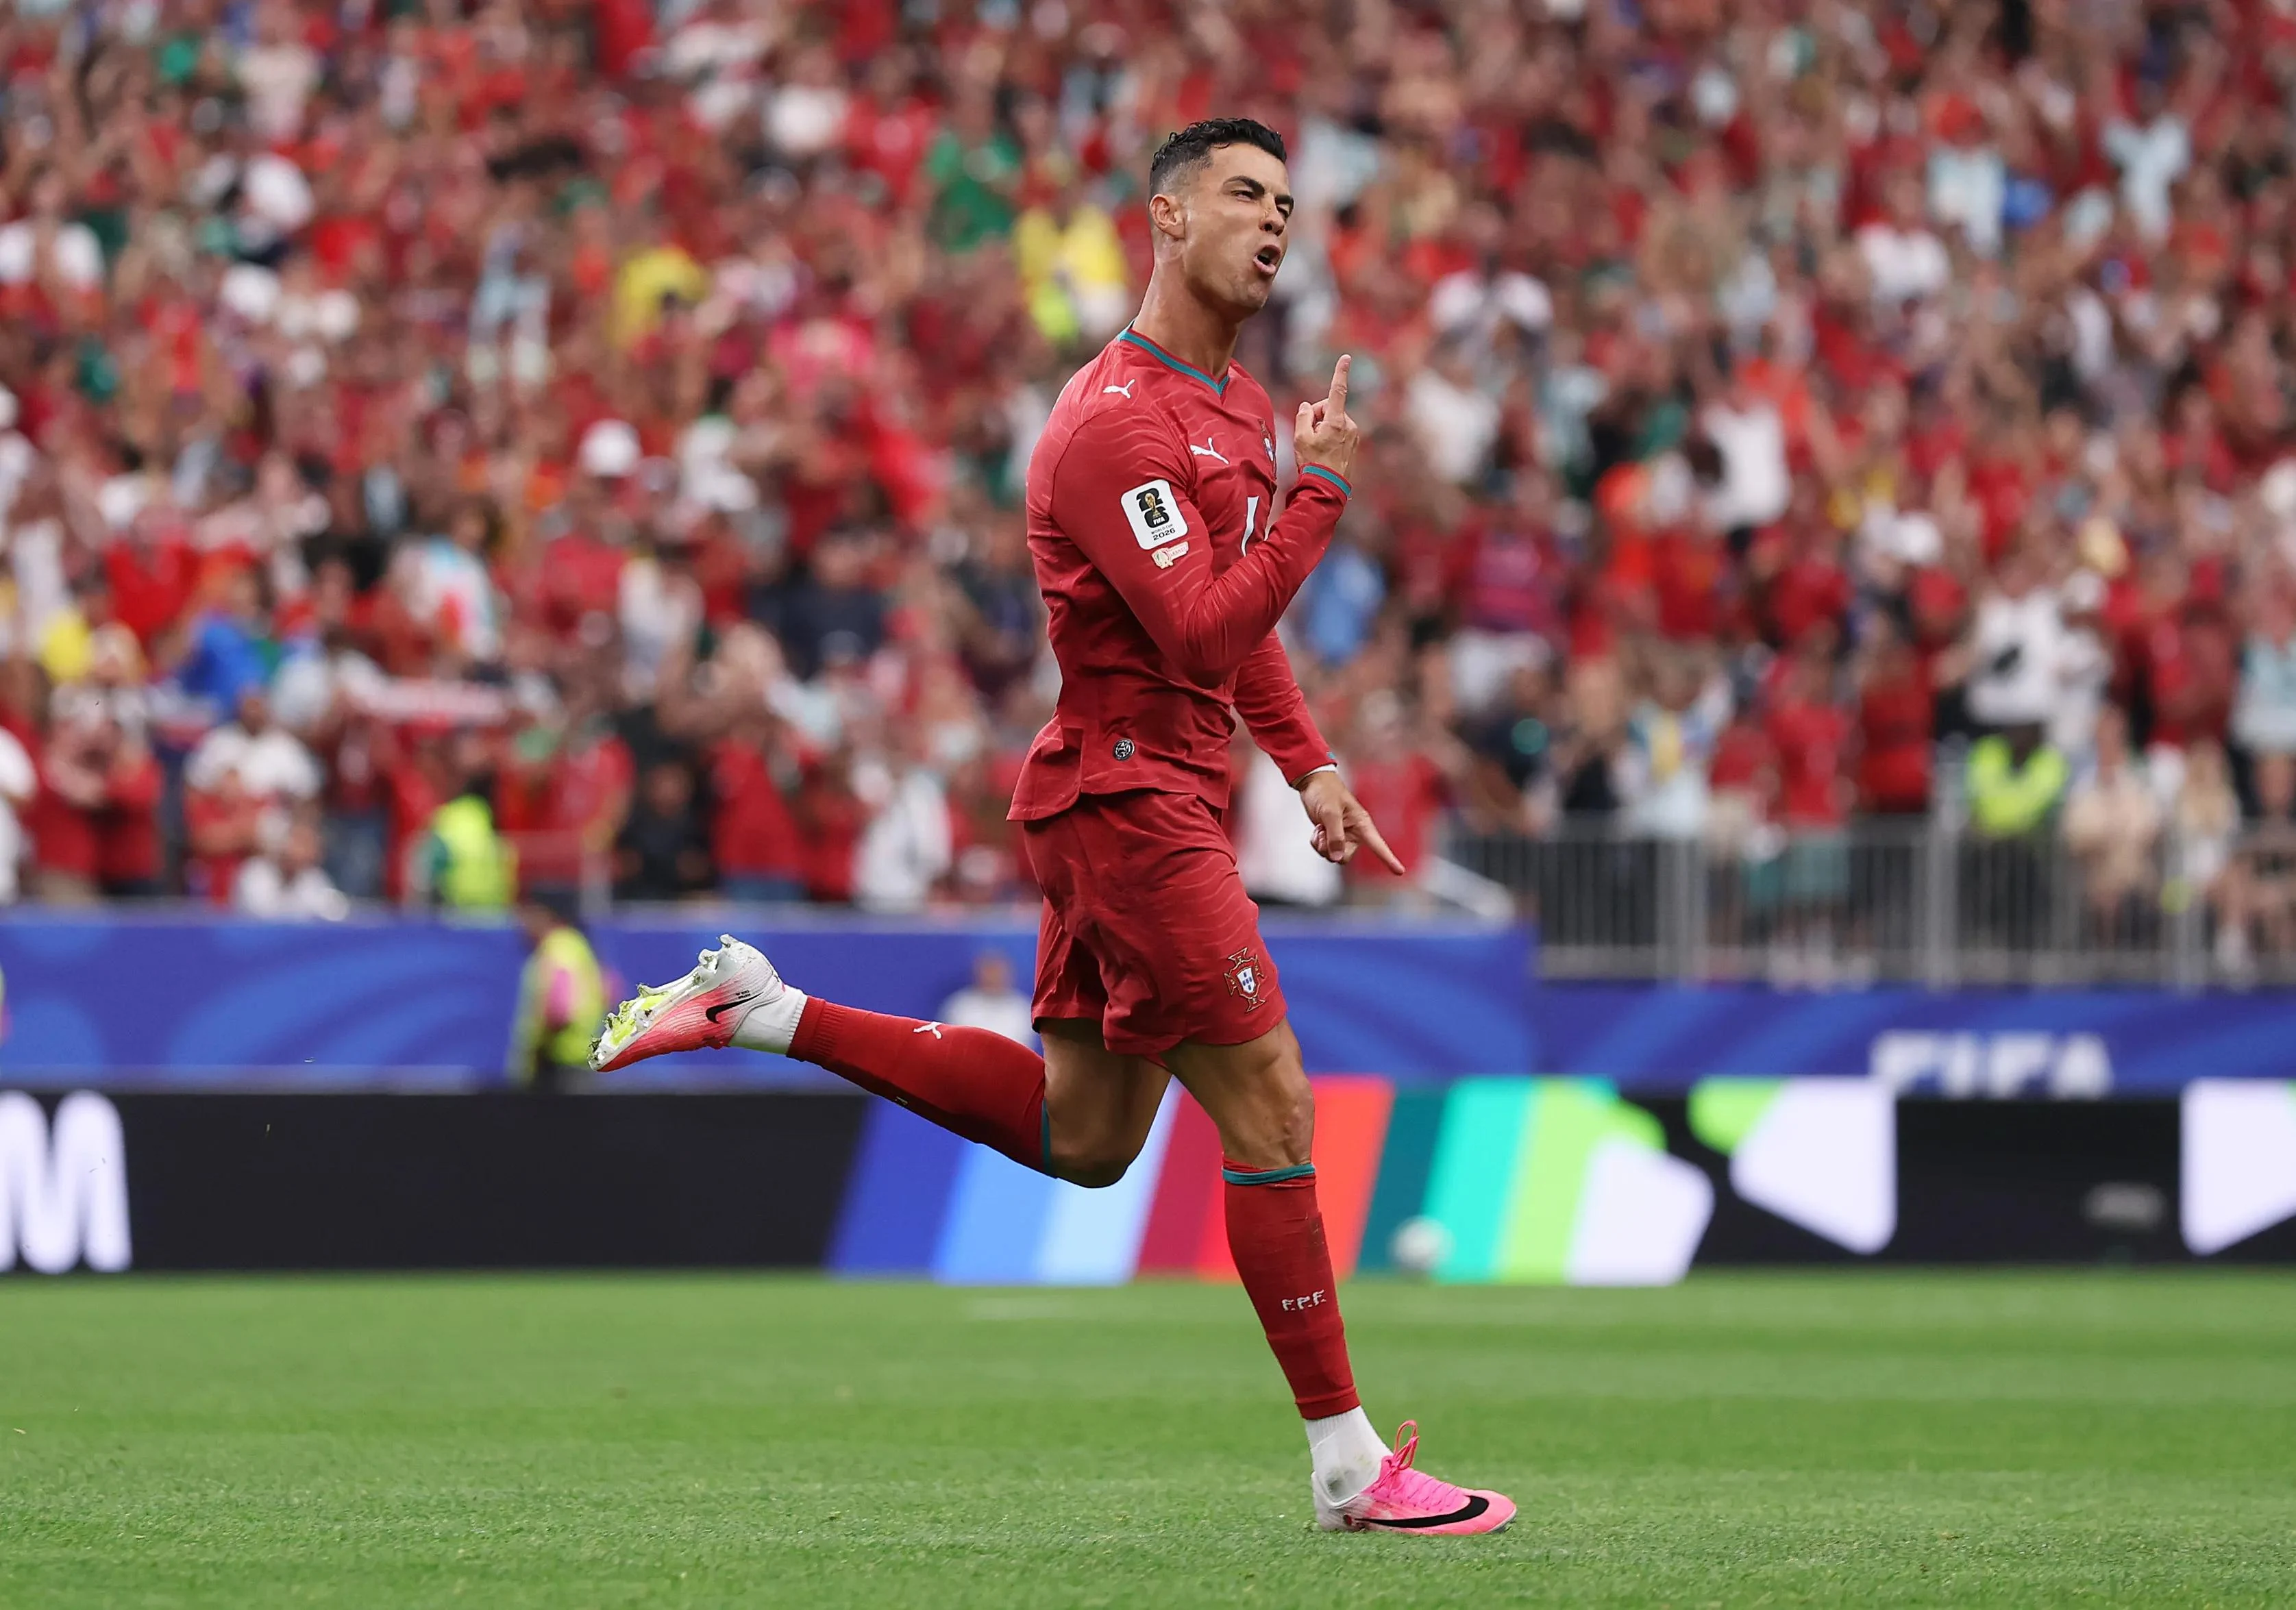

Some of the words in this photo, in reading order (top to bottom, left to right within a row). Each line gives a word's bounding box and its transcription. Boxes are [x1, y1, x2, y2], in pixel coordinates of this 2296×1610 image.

[1153, 517, 1165, 525] FIFA
[1152, 528, 1176, 541] 2026
[1871, 1031, 2112, 1098] FIFA
